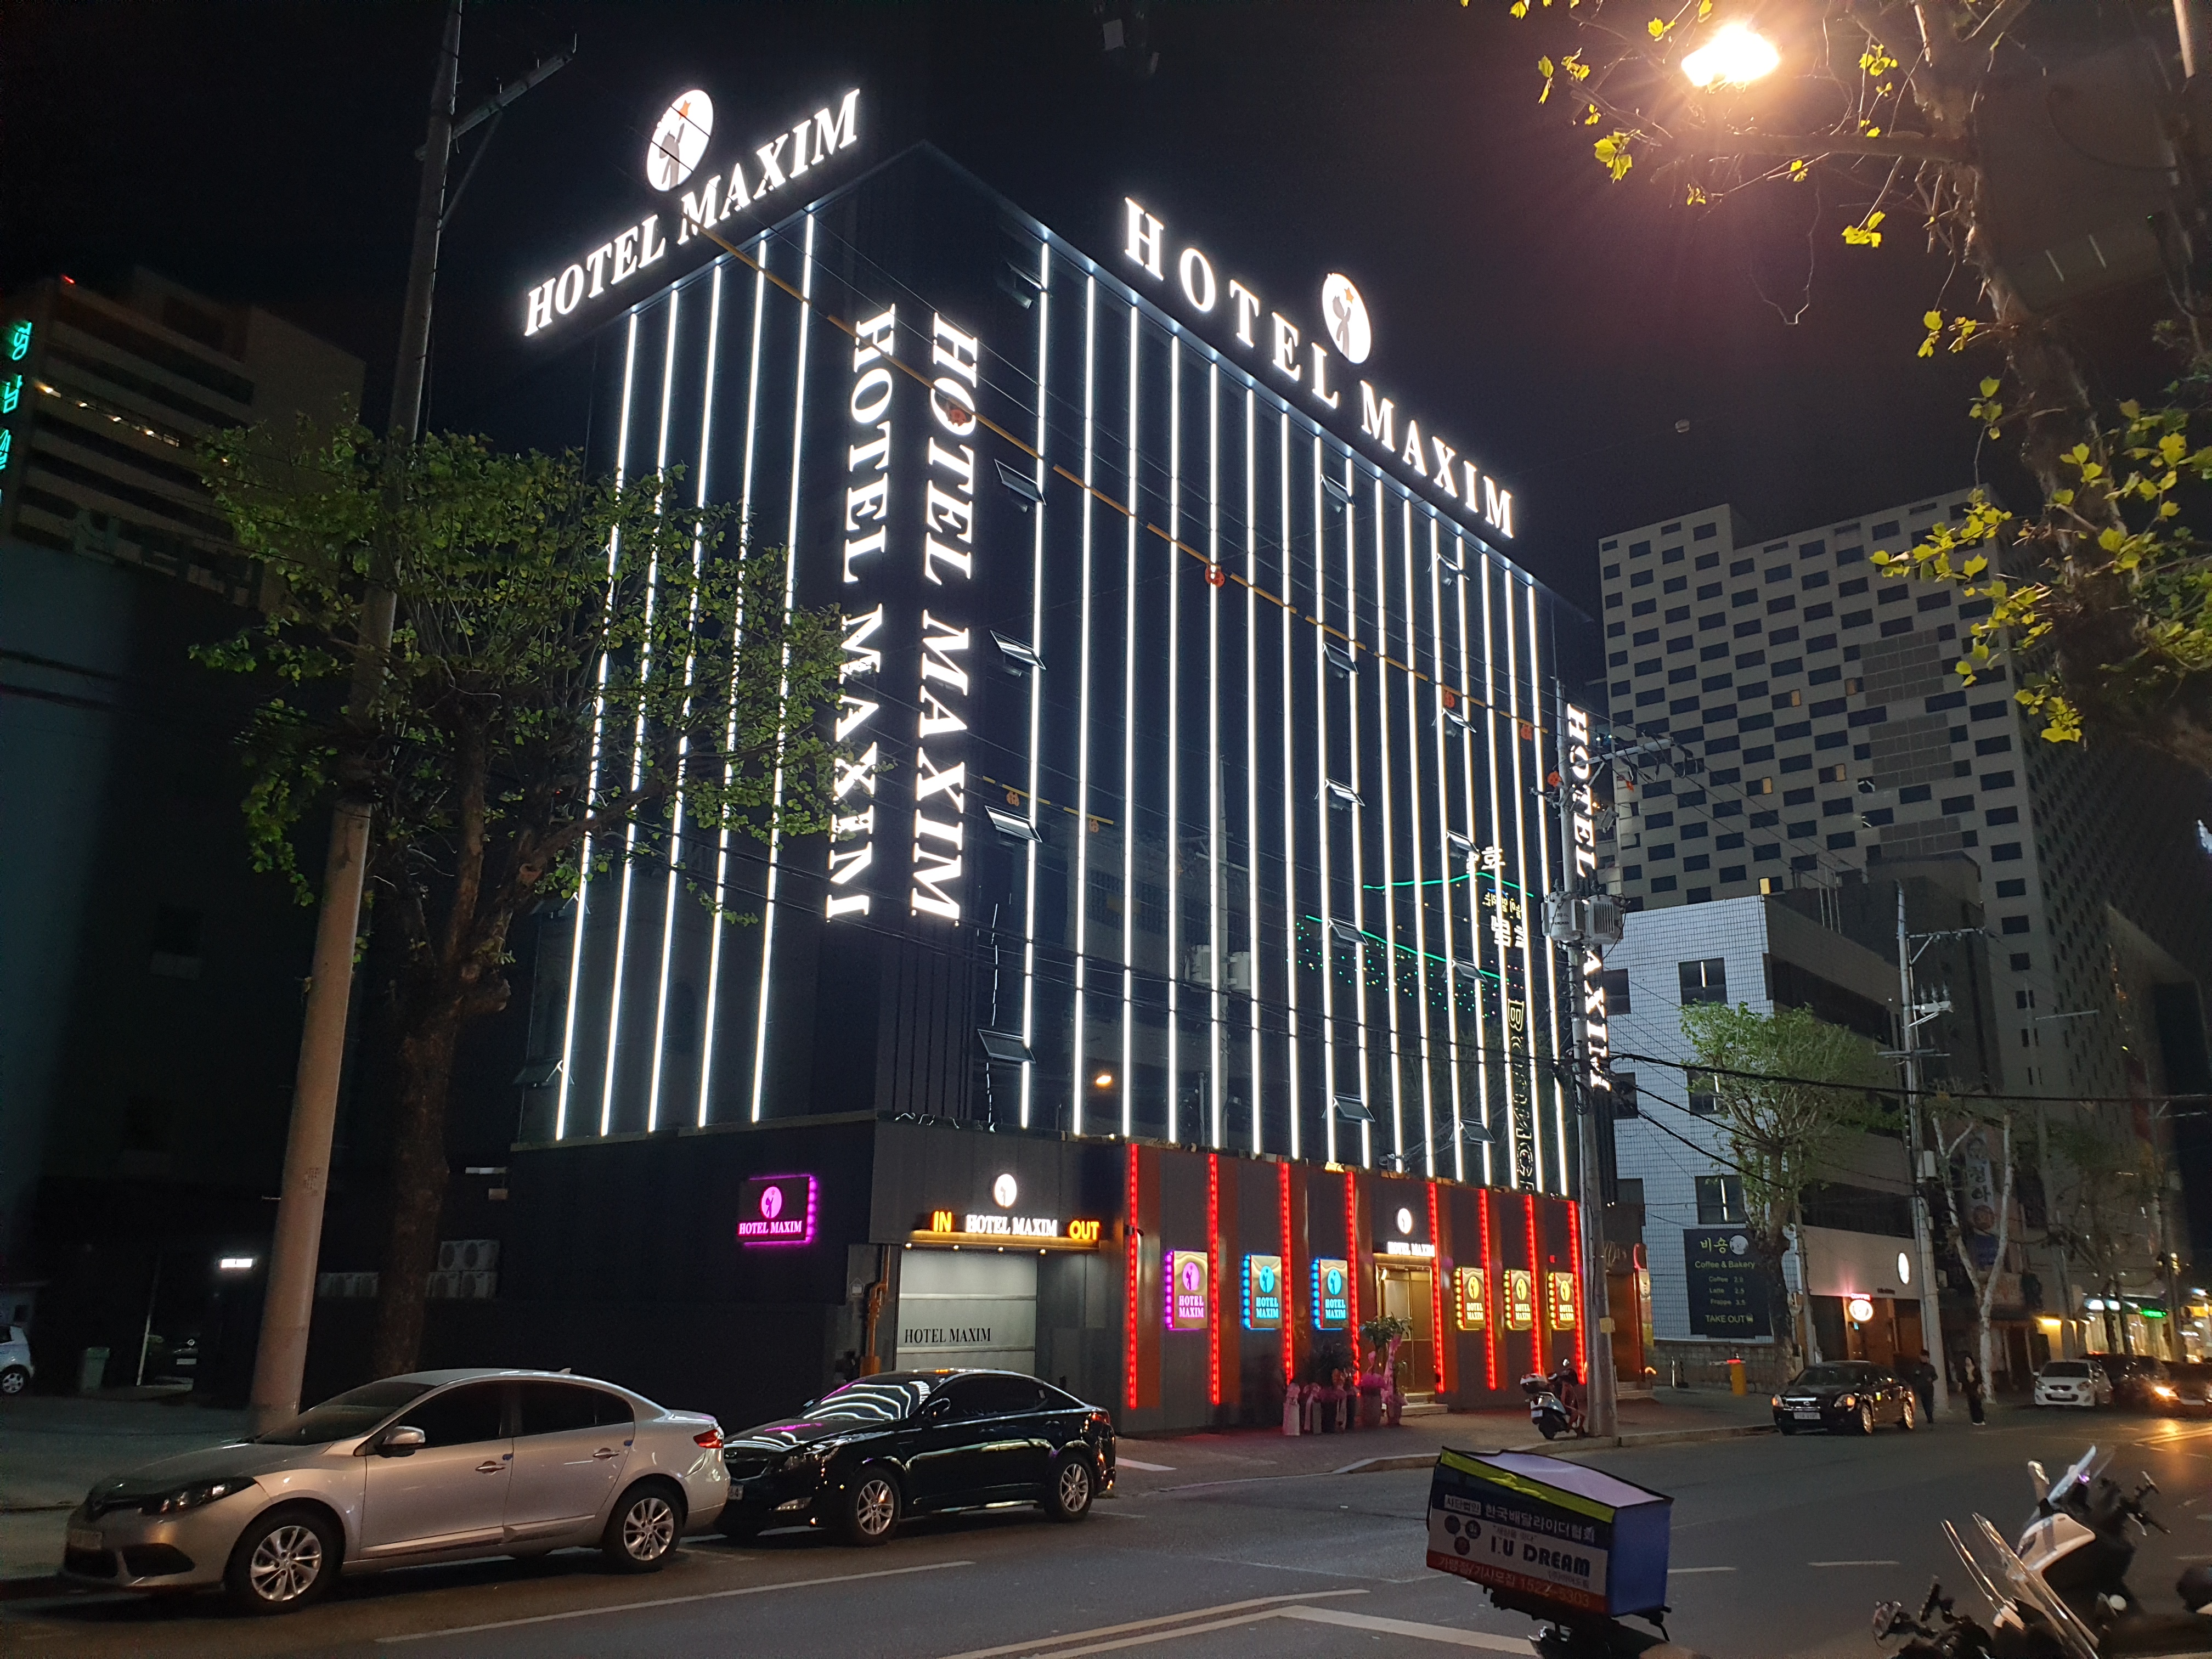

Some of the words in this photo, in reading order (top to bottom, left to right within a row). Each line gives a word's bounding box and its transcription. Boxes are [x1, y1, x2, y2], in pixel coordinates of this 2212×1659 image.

[524, 215, 665, 336] HOTEL
[677, 88, 860, 245] MAXIM
[1125, 197, 1338, 409] HOTEL
[1361, 380, 1513, 538] MAXIM
[844, 303, 895, 584] HOTEL
[924, 312, 978, 585] HOTEL
[912, 609, 969, 927] MAXIM
[1582, 900, 1612, 1092] AXIM
[739, 1221, 768, 1235] HOTEL
[770, 1220, 802, 1234] MAXIM
[933, 1211, 952, 1232] IN
[966, 1214, 1010, 1235] HOTEL
[1012, 1216, 1057, 1237] MAXIM
[1069, 1220, 1099, 1240] OUT
[1728, 1261, 1756, 1269] Bakery
[1179, 1295, 1204, 1306] HOTEL
[1256, 1297, 1279, 1307] HOTEL
[1325, 1299, 1346, 1308] HOTEL
[1466, 1302, 1483, 1311] HOTEL
[1179, 1307, 1204, 1318] MAXIM
[1256, 1308, 1279, 1318] MAXIM
[1325, 1309, 1346, 1319] MAXIM
[1515, 1304, 1531, 1312] HOTEL
[1466, 1312, 1484, 1321] MAXIM
[1515, 1312, 1531, 1321] MAXIM
[1705, 1314, 1726, 1323] TAKE
[1728, 1314, 1745, 1323] OUT
[905, 1328, 947, 1344] HOTEL
[949, 1328, 991, 1342] MAXIM
[1523, 1544, 1590, 1577] DREAM
